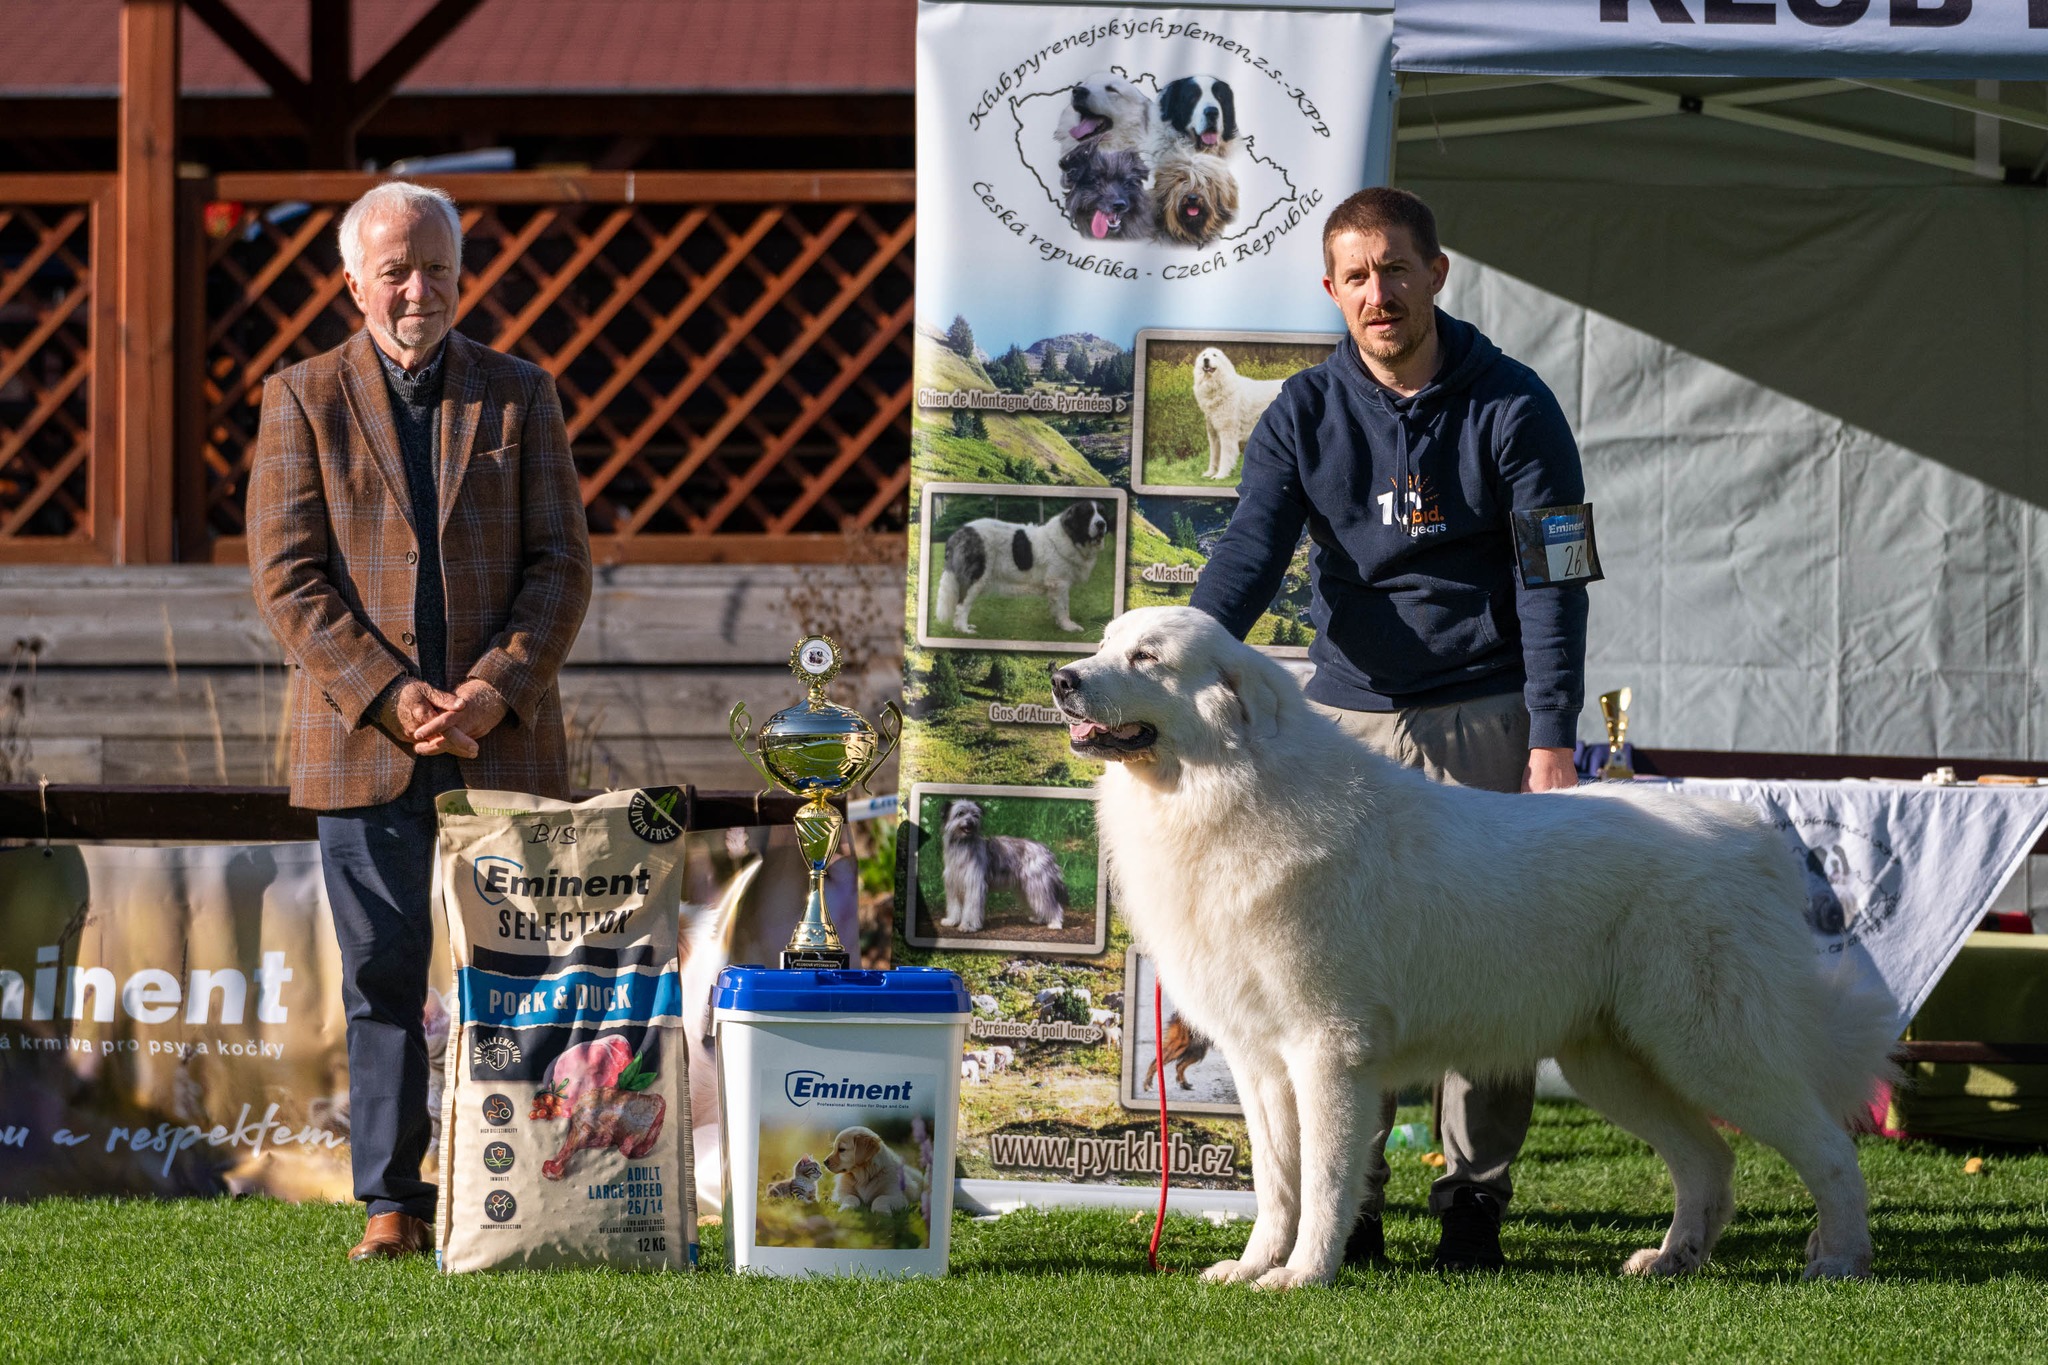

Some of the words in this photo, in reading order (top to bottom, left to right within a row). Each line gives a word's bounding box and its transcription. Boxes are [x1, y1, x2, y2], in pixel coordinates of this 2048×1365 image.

[969, 72, 1012, 131] Klub
[1014, 17, 1164, 87] pyrenejských
[973, 181, 1029, 236] Česká
[1028, 233, 1139, 280] republika
[1162, 251, 1227, 281] Czech
[1233, 188, 1323, 262] Republic
[919, 389, 949, 407] Chien
[952, 392, 967, 407] de
[971, 392, 1029, 411] Montagne
[1032, 394, 1053, 410] des
[1057, 393, 1111, 412] Pyrénées
[1411, 523, 1447, 537] years
[1548, 522, 1585, 534] Eminent
[1154, 565, 1194, 581] Mastín
[1565, 545, 1583, 578] 26
[991, 704, 1014, 720] Gos
[631, 797, 650, 836] GLUTEN
[650, 825, 676, 840] FREE
[484, 865, 651, 898] Eminent
[499, 909, 634, 942] SELECTION
[489, 989, 547, 1016] PORK
[552, 986, 569, 1010] &
[575, 983, 632, 1012] DUCK
[975, 1019, 1028, 1037] Pyrénées
[1042, 1023, 1064, 1039] poil
[1067, 1024, 1093, 1042] long
[20, 1034, 92, 1052] krmiva
[102, 1038, 140, 1056] pro
[150, 1038, 187, 1058] psy
[196, 1041, 209, 1054] a
[217, 1039, 285, 1059] kočky
[473, 1036, 522, 1065] HYPOALLERGENIC
[793, 1077, 913, 1101] Eminent
[53, 1128, 90, 1146] a
[106, 1102, 346, 1178] respektem
[627, 1166, 660, 1181] ADULT
[588, 1184, 625, 1199] LARGE
[628, 1183, 663, 1198] BREED
[627, 1199, 663, 1215] 26/14
[637, 1238, 650, 1252] 12
[652, 1237, 666, 1252] KG
